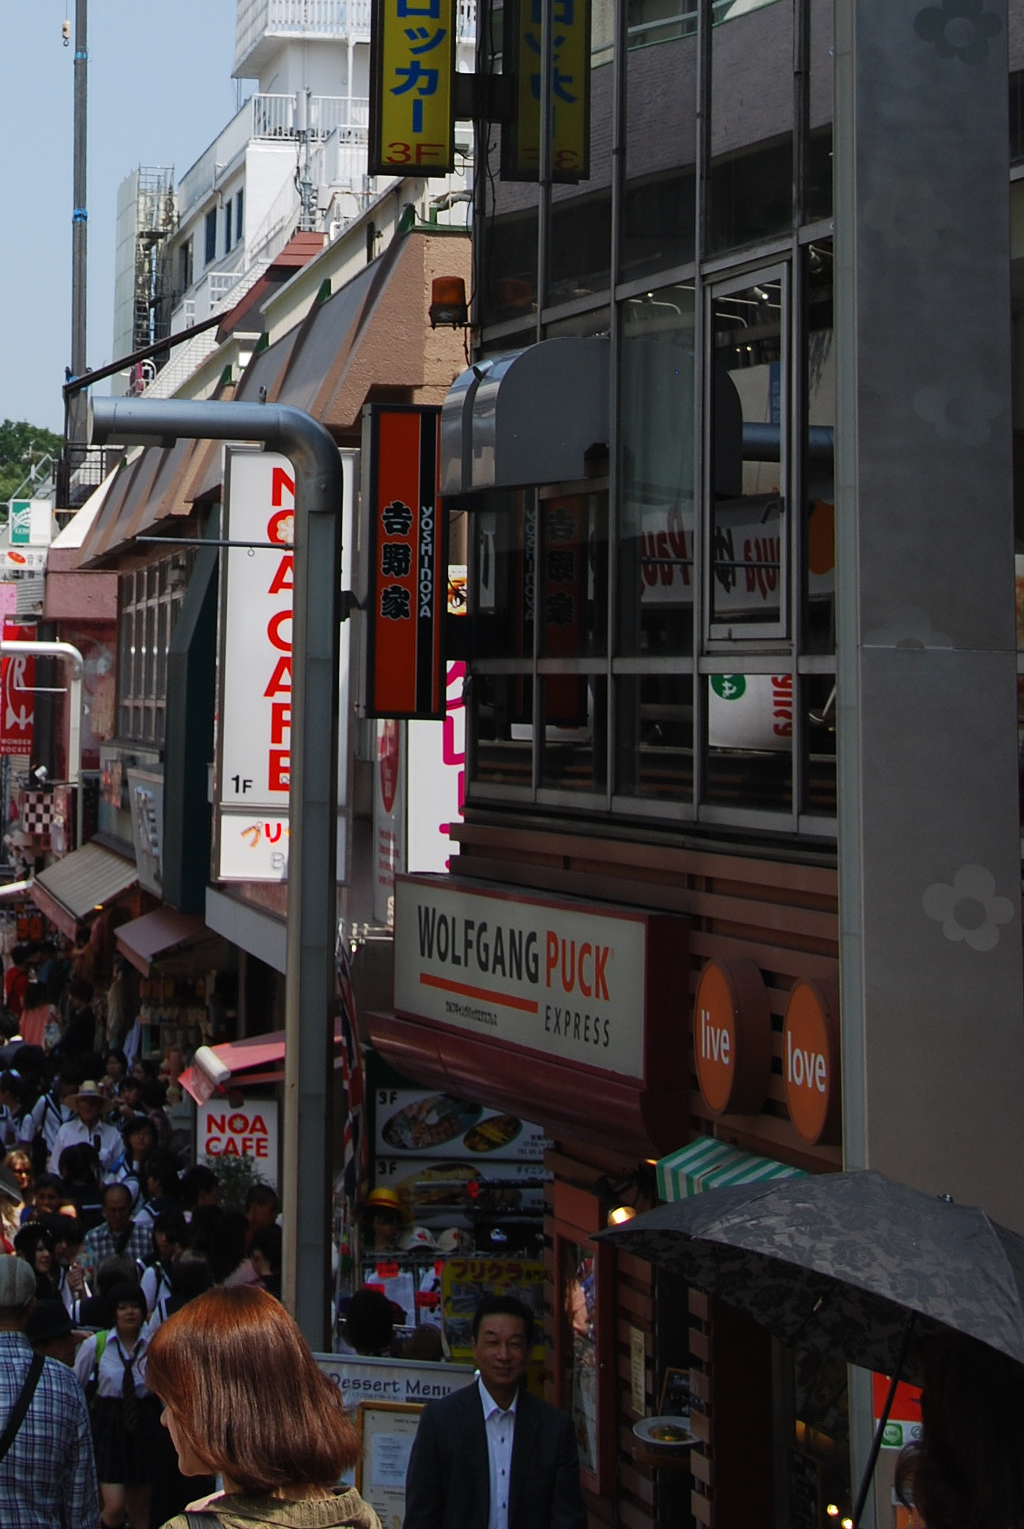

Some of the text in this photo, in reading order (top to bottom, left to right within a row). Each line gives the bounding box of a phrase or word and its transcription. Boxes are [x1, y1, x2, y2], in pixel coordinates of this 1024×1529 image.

[386, 142, 446, 165] 3F
[381, 500, 413, 620] 吉野家
[420, 506, 433, 618] YOSHINOYA
[231, 774, 253, 794] 1F
[240, 821, 289, 849] プリ
[417, 905, 610, 1002] WOLFGANG PUCK
[545, 1005, 610, 1048] EXPRESS
[701, 1009, 730, 1065] live
[787, 1030, 826, 1093] love
[379, 1091, 398, 1105] 3F
[207, 1113, 268, 1136] NOA
[205, 1136, 269, 1158] CAFE
[378, 1161, 397, 1175] 3F
[329, 1372, 400, 1391] Dessert
